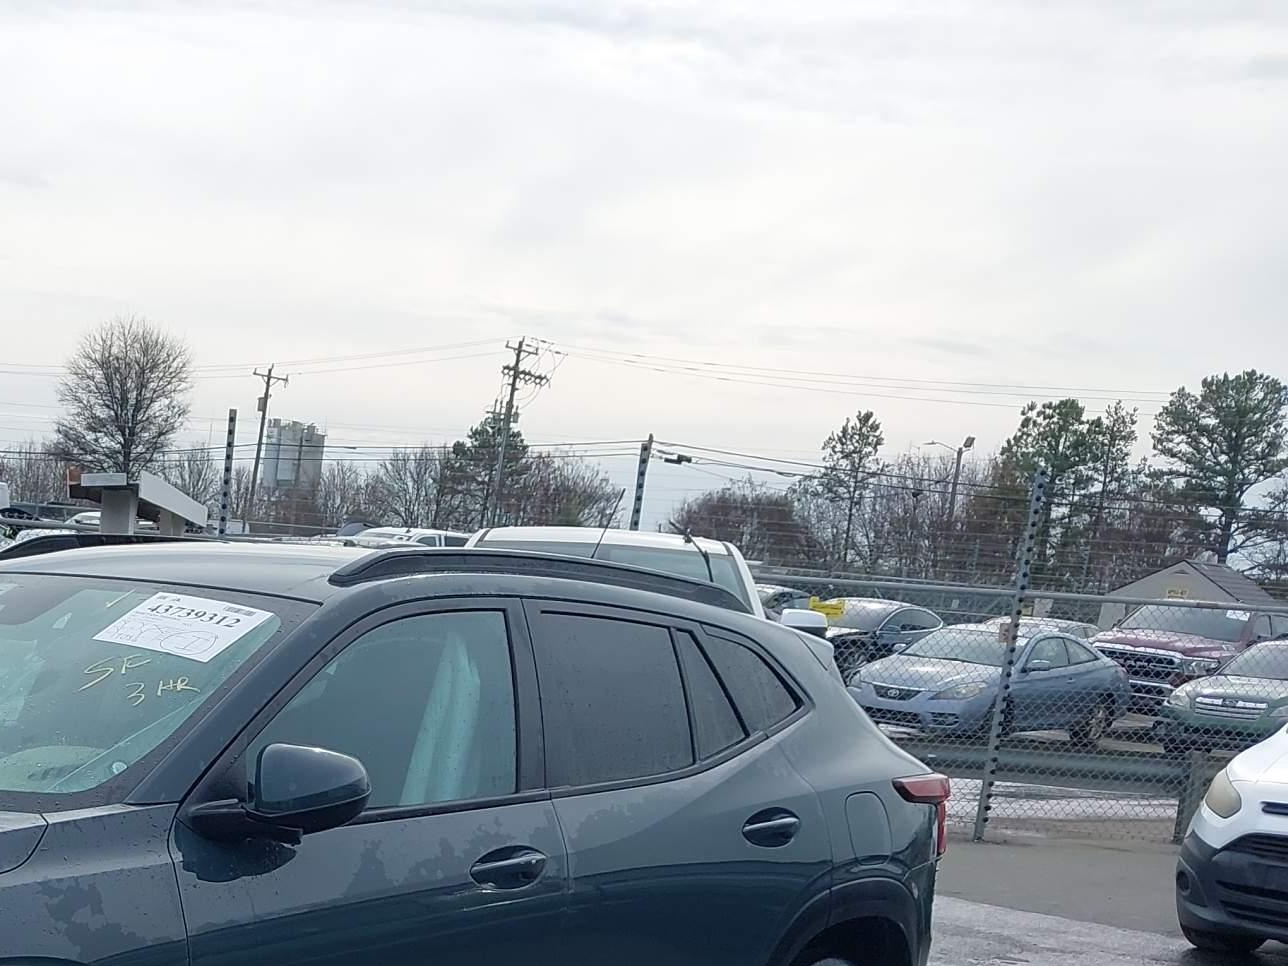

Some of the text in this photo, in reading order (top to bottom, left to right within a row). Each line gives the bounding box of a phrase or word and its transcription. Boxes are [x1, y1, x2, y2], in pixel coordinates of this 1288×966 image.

[147, 604, 240, 628] 43739312
[125, 677, 200, 706] 3 HR
